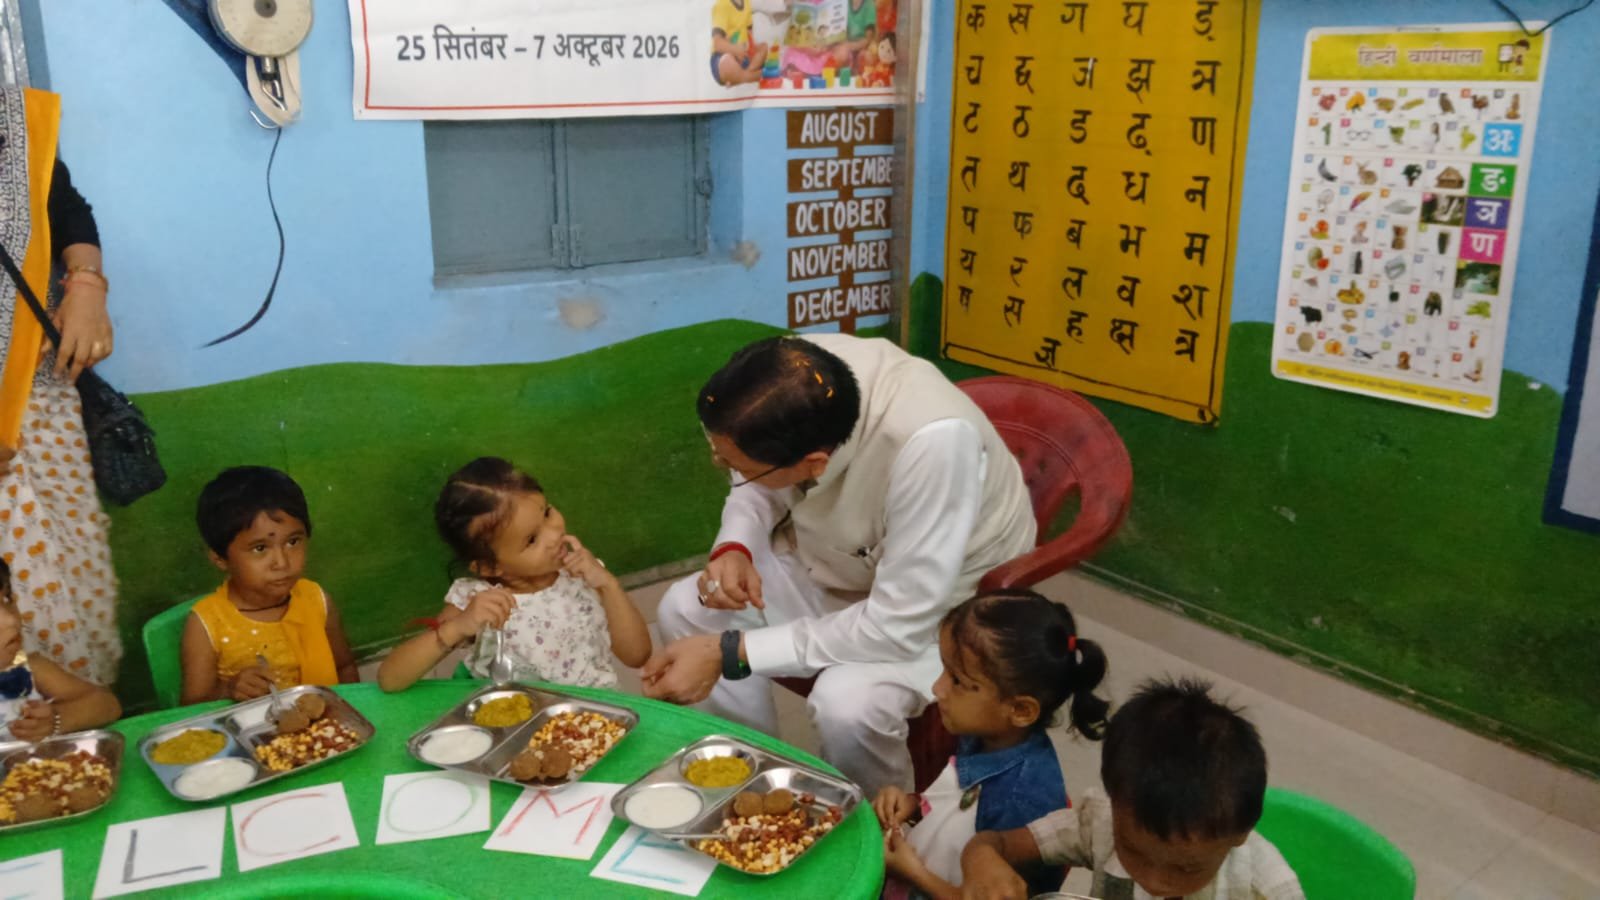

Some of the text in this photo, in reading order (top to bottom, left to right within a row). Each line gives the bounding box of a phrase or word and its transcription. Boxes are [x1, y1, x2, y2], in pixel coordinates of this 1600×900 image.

[966, 4, 986, 32] क
[1008, 4, 1034, 34] ख
[1060, 3, 1088, 32] ग
[1122, 1, 1148, 36] घ
[397, 35, 426, 61] 25
[432, 24, 508, 60] सितंबर
[533, 35, 546, 59] 7
[553, 33, 626, 66] अक्टूबर
[632, 35, 680, 60] 2026
[965, 55, 985, 86] च
[1015, 56, 1034, 94] छ
[1073, 57, 1098, 89] ज
[801, 111, 879, 144] AUGUST
[962, 102, 981, 134] ट
[1013, 105, 1033, 138] ठ
[1070, 110, 1092, 144] ड
[1189, 117, 1217, 155] ण
[801, 156, 893, 190] SEPTEMBE
[961, 156, 981, 192] त
[1008, 161, 1030, 192] थ
[1067, 166, 1090, 205] द
[1184, 176, 1210, 211] न
[1480, 167, 1507, 192] ङ
[795, 198, 887, 234] OCTOBER
[961, 206, 1210, 267] प फ ब भ म
[1469, 232, 1498, 258] ण
[791, 239, 888, 278] NOVEMBER
[795, 284, 891, 323] DECEMBER
[960, 249, 1209, 320] य र ल व श
[1004, 296, 1025, 328] स
[1066, 310, 1088, 344] ह
[122, 829, 208, 884] L
[239, 792, 341, 857] C
[499, 788, 606, 846] M
